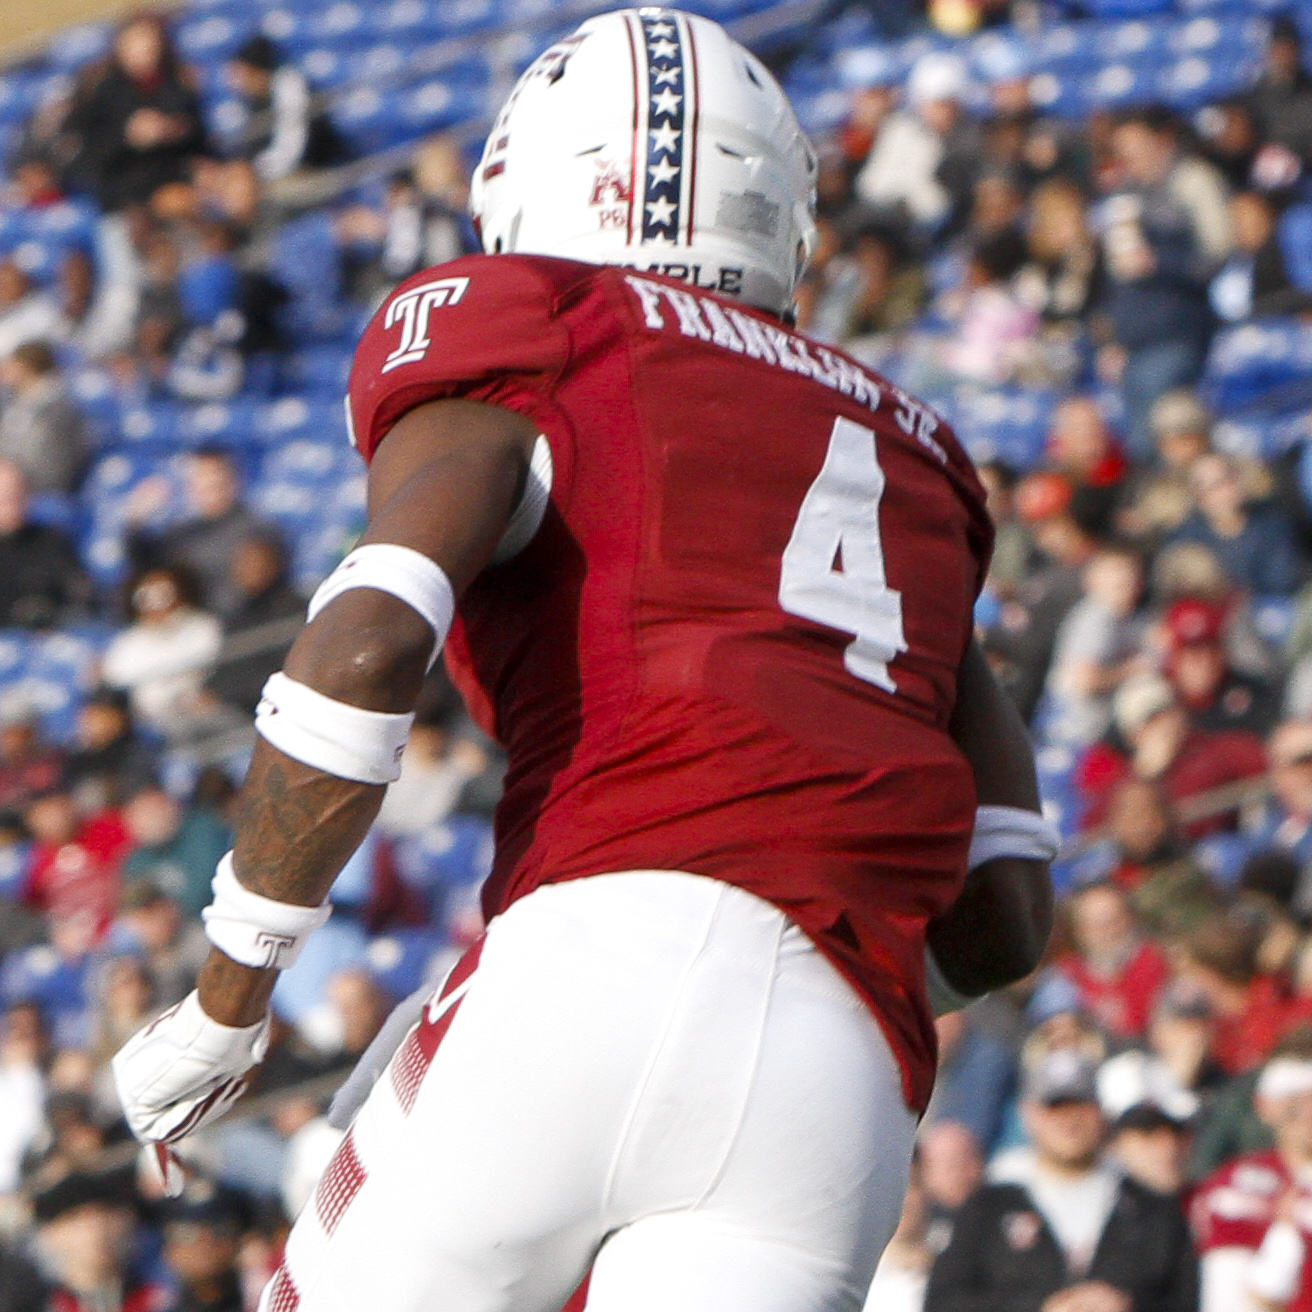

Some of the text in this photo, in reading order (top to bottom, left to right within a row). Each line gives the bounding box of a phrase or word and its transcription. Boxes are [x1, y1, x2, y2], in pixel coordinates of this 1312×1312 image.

[381, 276, 470, 375] T
[624, 274, 881, 412] FRANKLIN
[778, 415, 908, 694] 4
